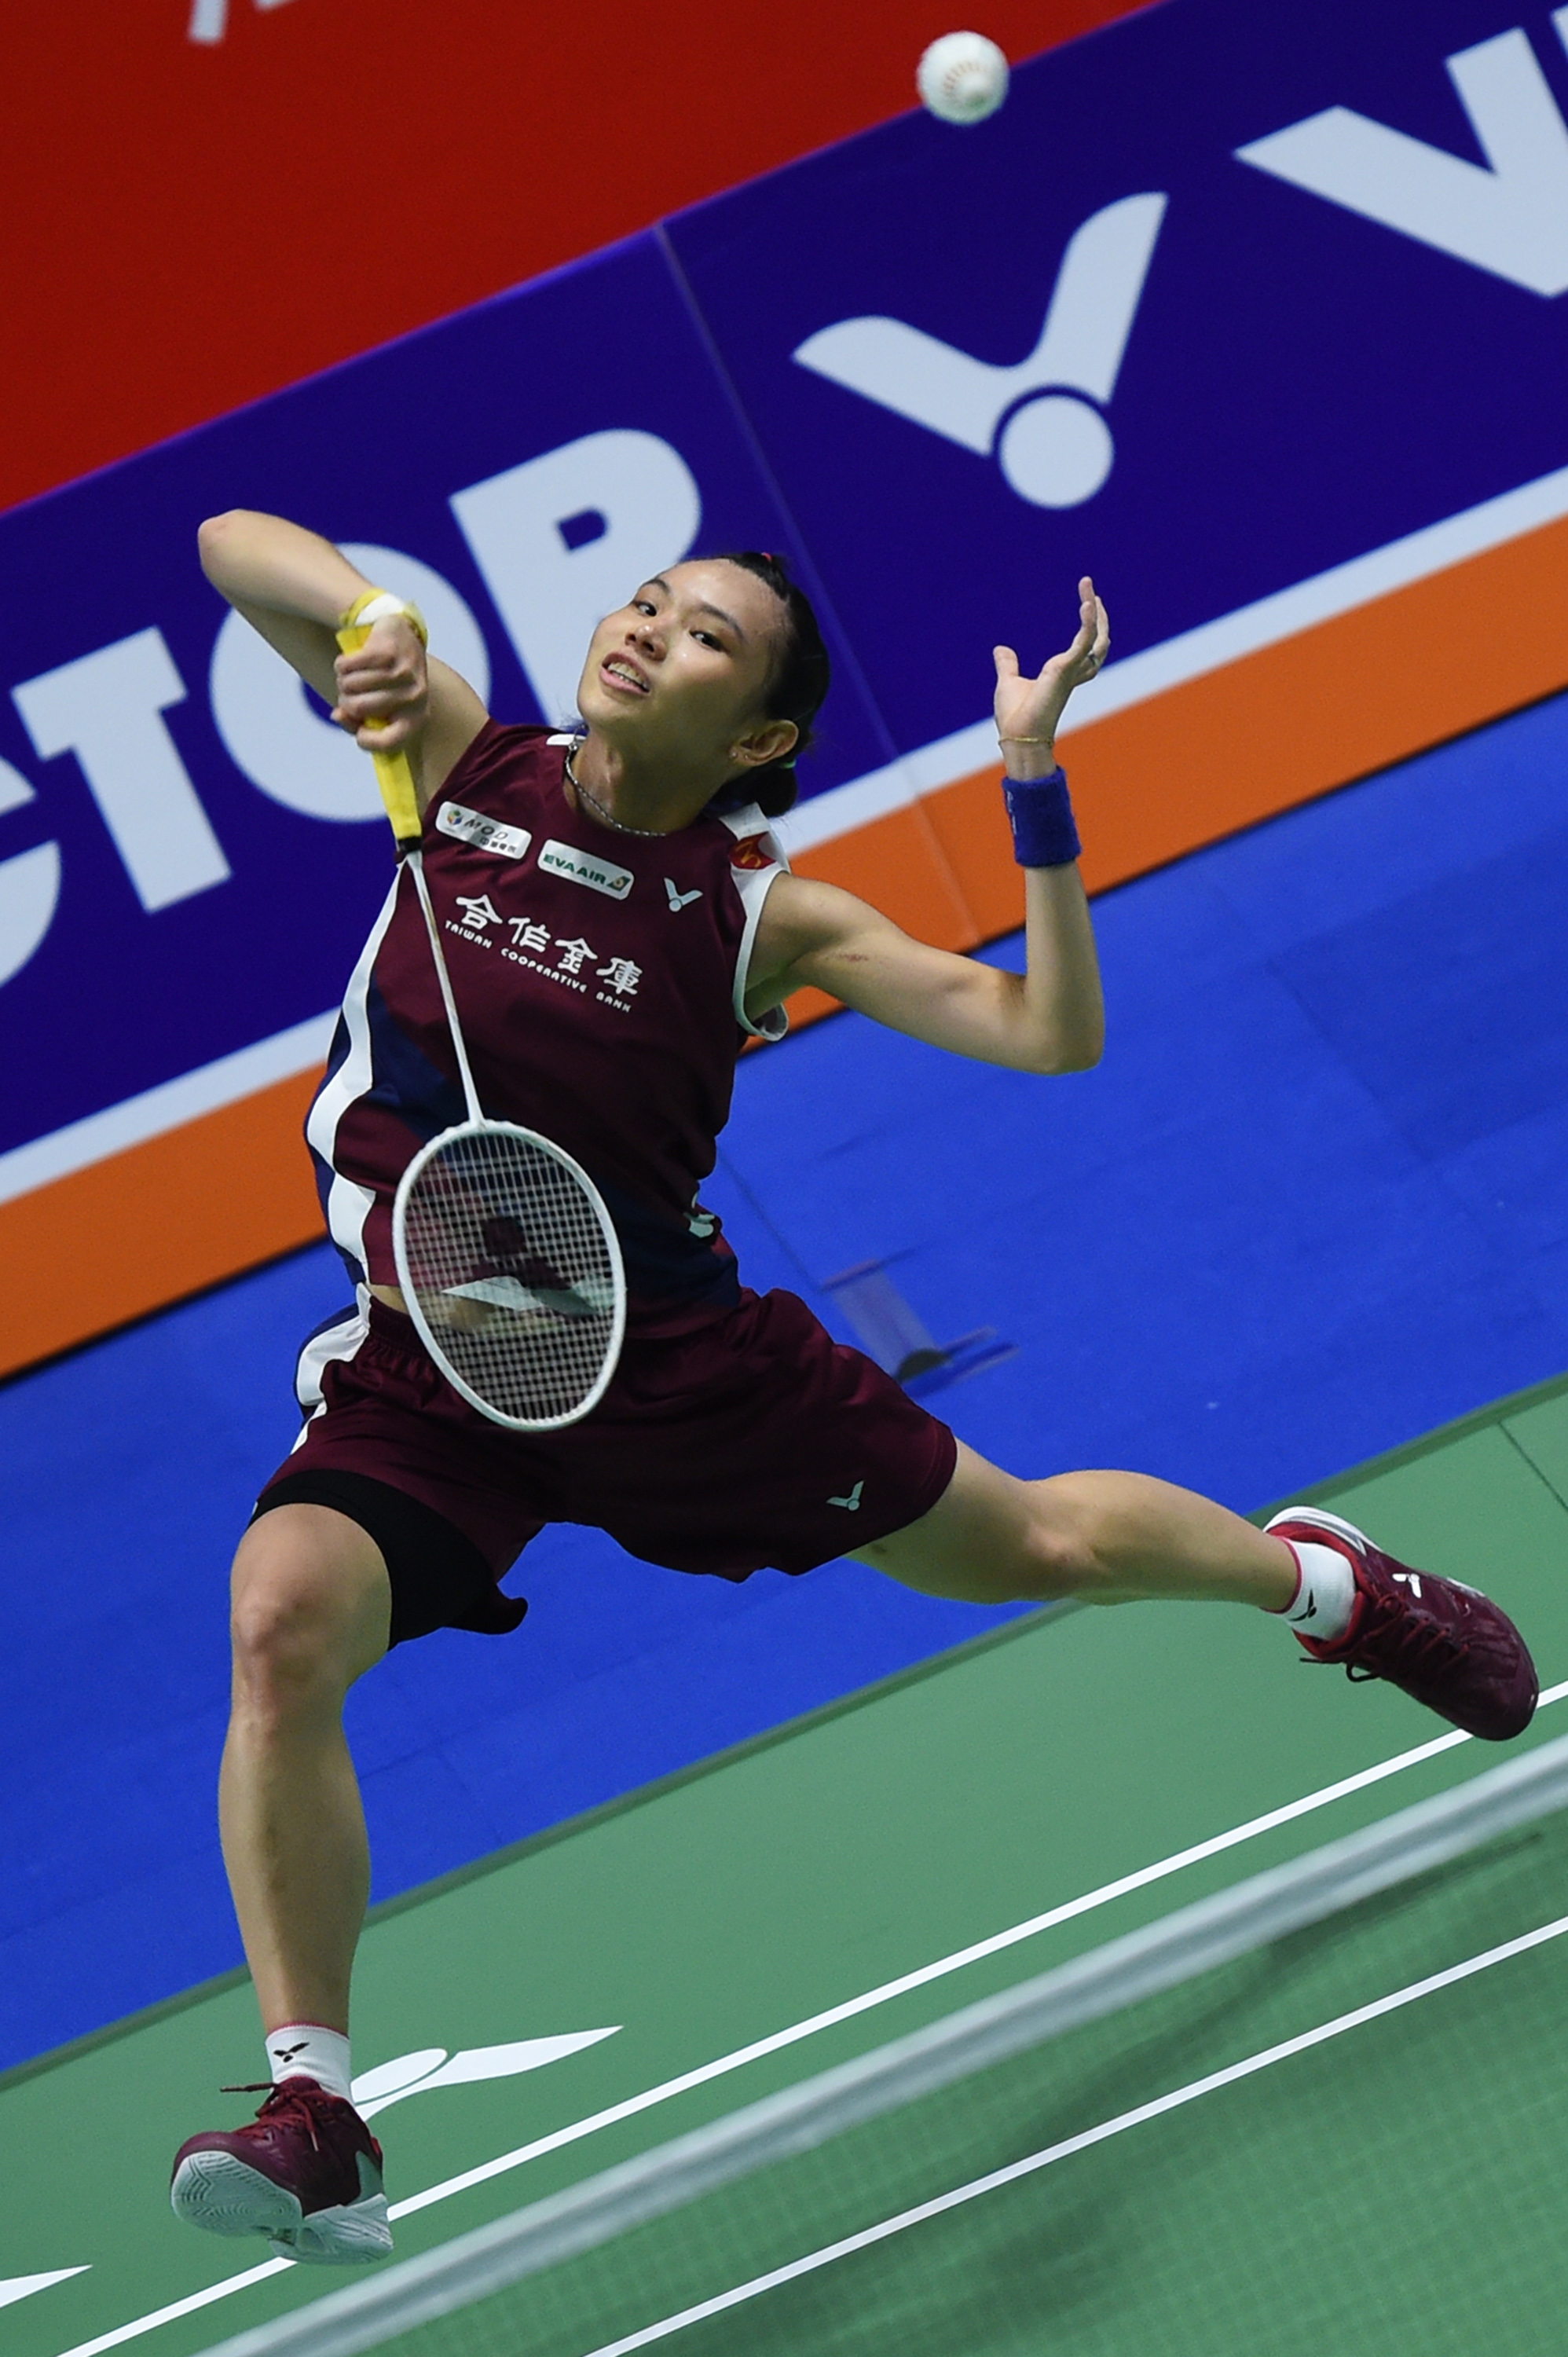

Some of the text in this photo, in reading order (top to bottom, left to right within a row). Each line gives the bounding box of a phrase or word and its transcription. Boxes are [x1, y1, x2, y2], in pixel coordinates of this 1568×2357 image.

[464, 818, 508, 840] MOD
[445, 920, 632, 1013] TAIWAN COOPERATIVE BANK
